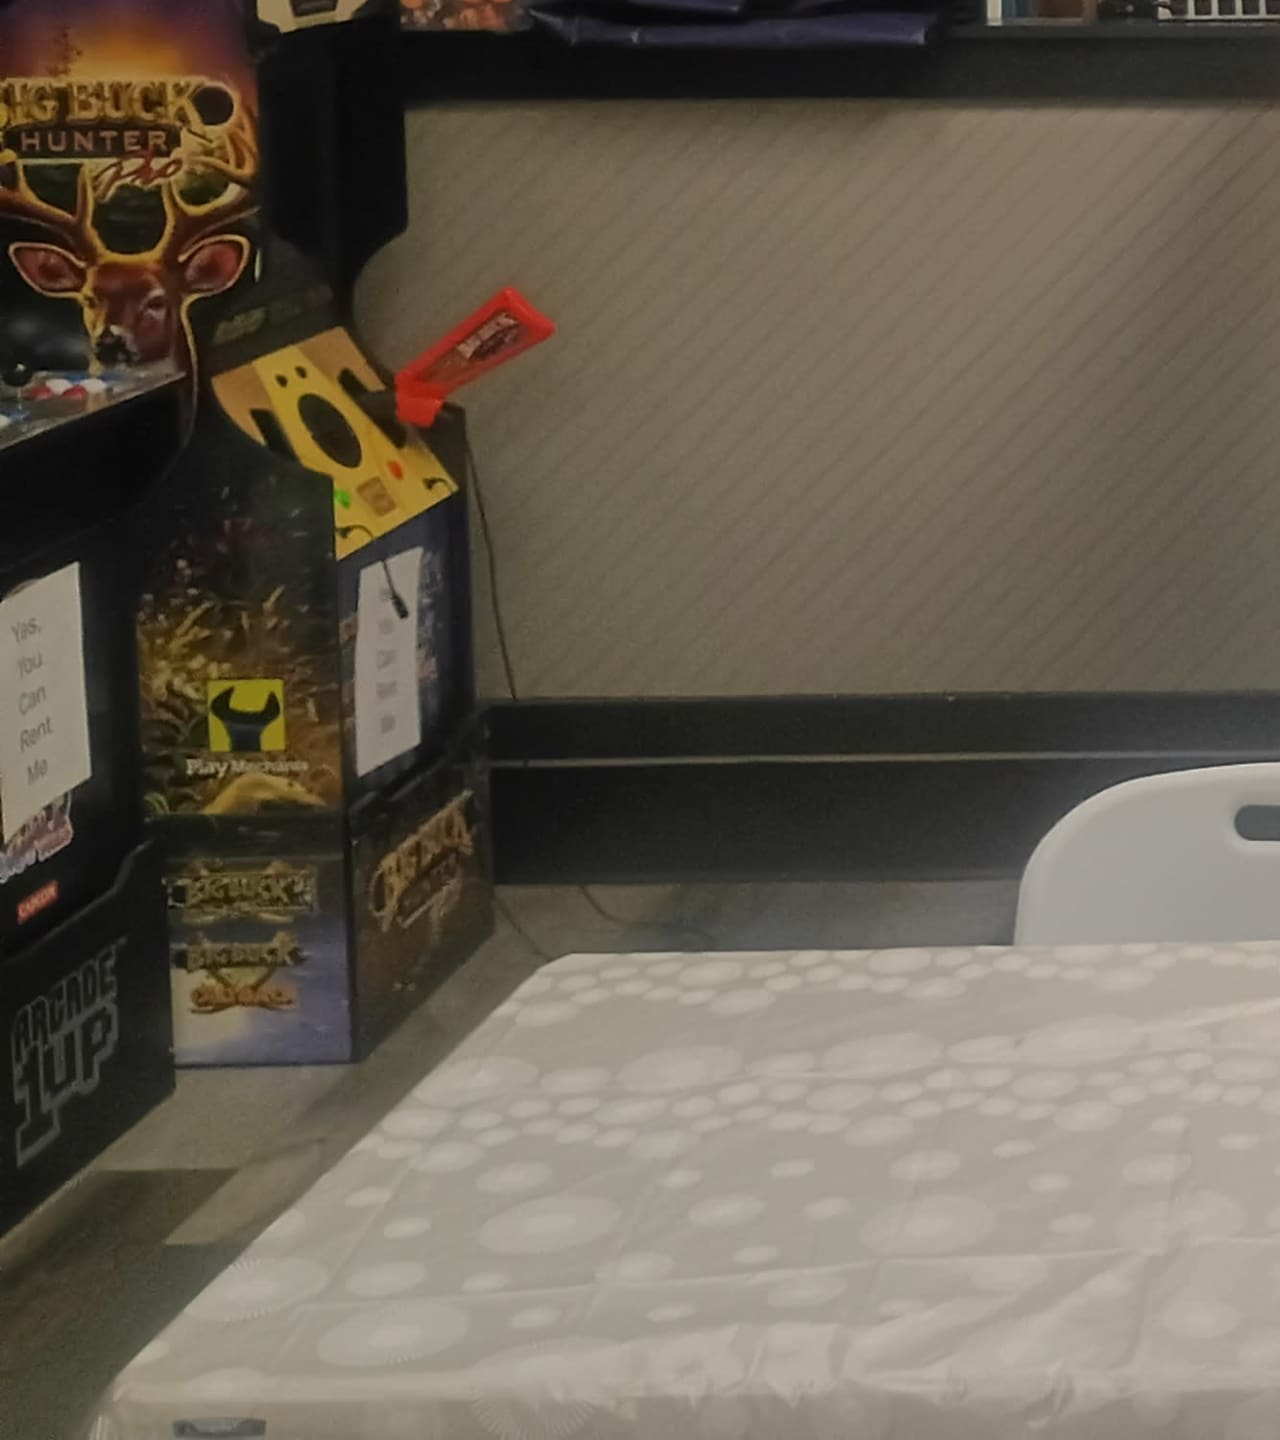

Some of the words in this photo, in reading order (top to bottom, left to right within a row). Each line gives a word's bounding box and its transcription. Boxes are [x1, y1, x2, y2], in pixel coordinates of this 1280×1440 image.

[66, 80, 203, 126] BUCK
[21, 130, 168, 152] HUNTER
[10, 617, 43, 644] Yes,
[18, 653, 44, 681] You
[17, 684, 48, 717] Can
[19, 715, 55, 754] Rent
[26, 757, 49, 787] Me
[186, 759, 227, 777] Play
[12, 942, 119, 1070] ARCADE
[14, 1000, 119, 1168] 1UP
